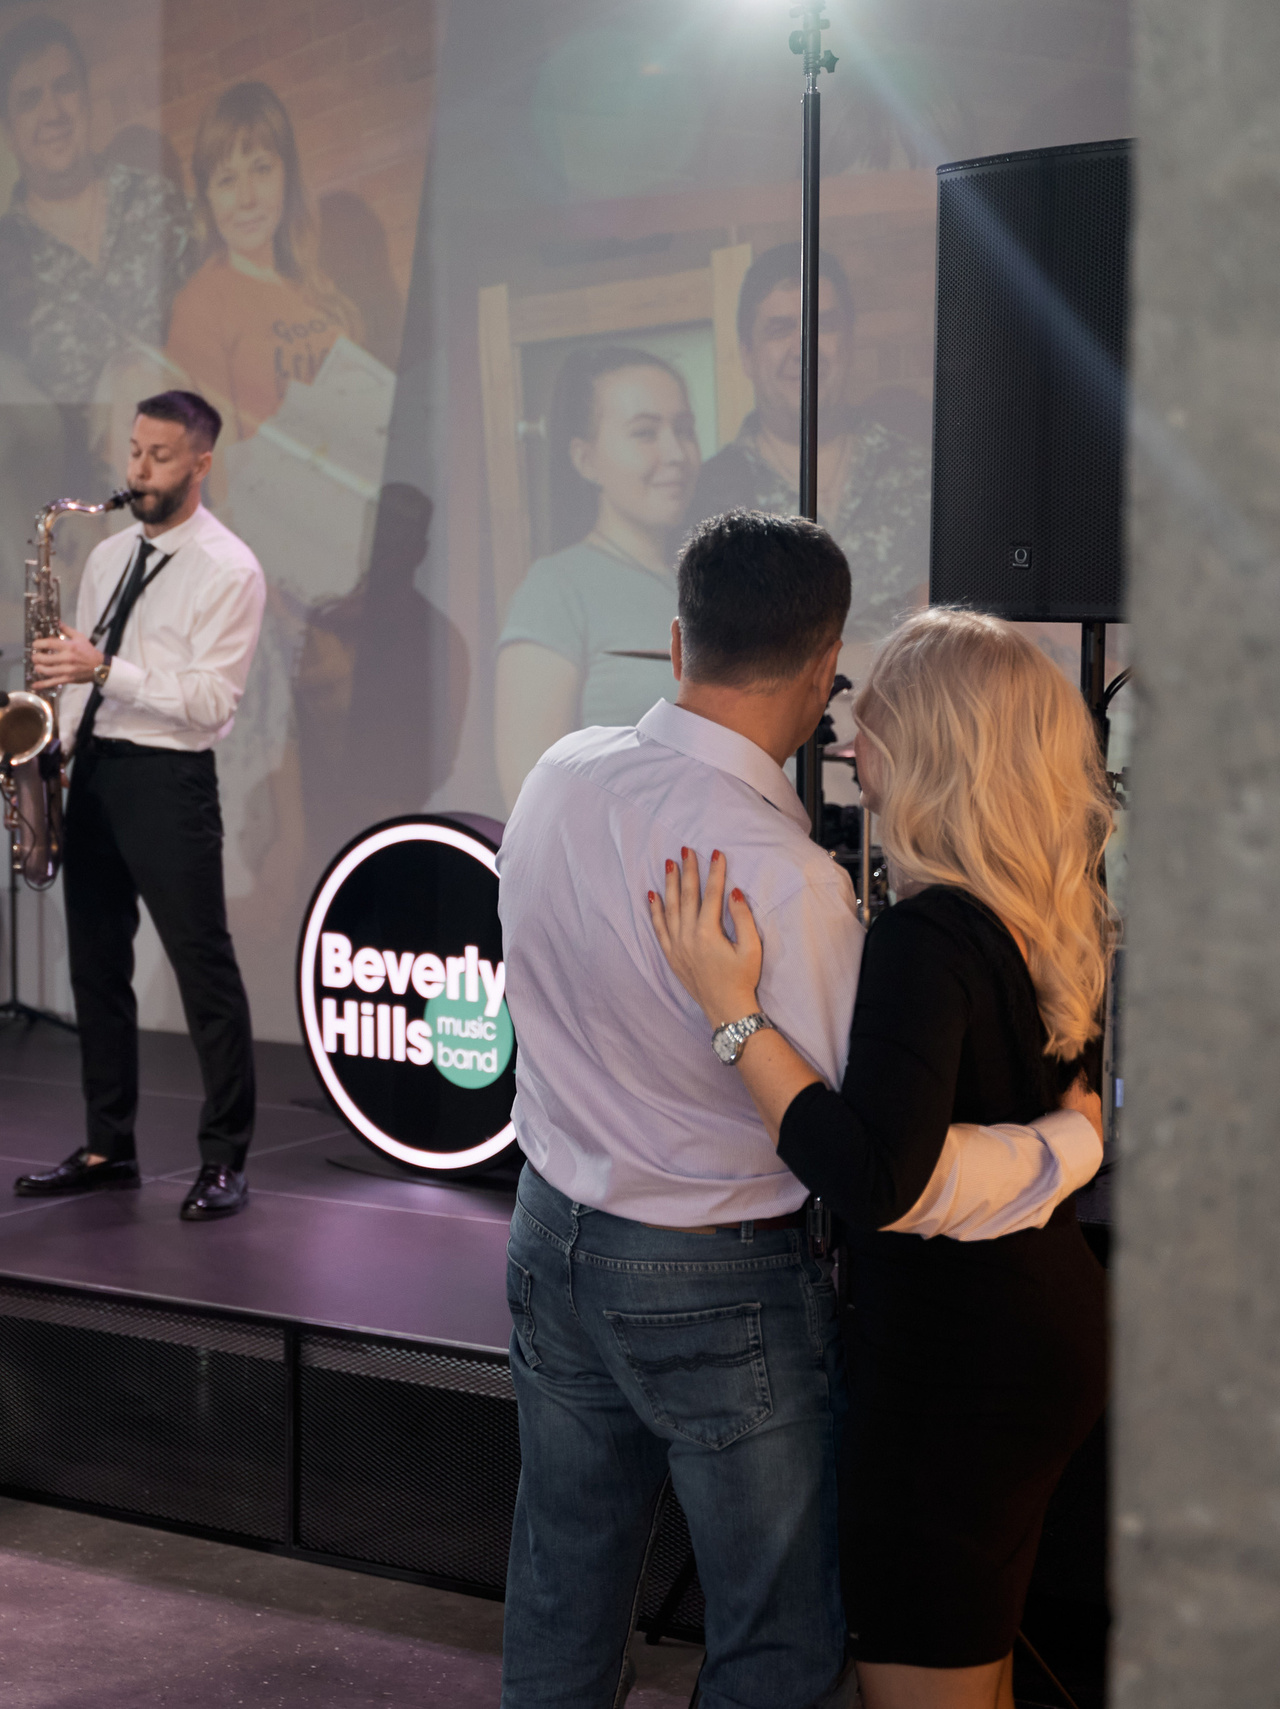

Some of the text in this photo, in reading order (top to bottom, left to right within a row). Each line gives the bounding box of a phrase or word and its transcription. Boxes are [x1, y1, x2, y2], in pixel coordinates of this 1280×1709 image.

[321, 932, 506, 1017] Beverly
[322, 998, 434, 1065] Hills
[436, 1015, 497, 1041] music
[436, 1042, 498, 1073] band
